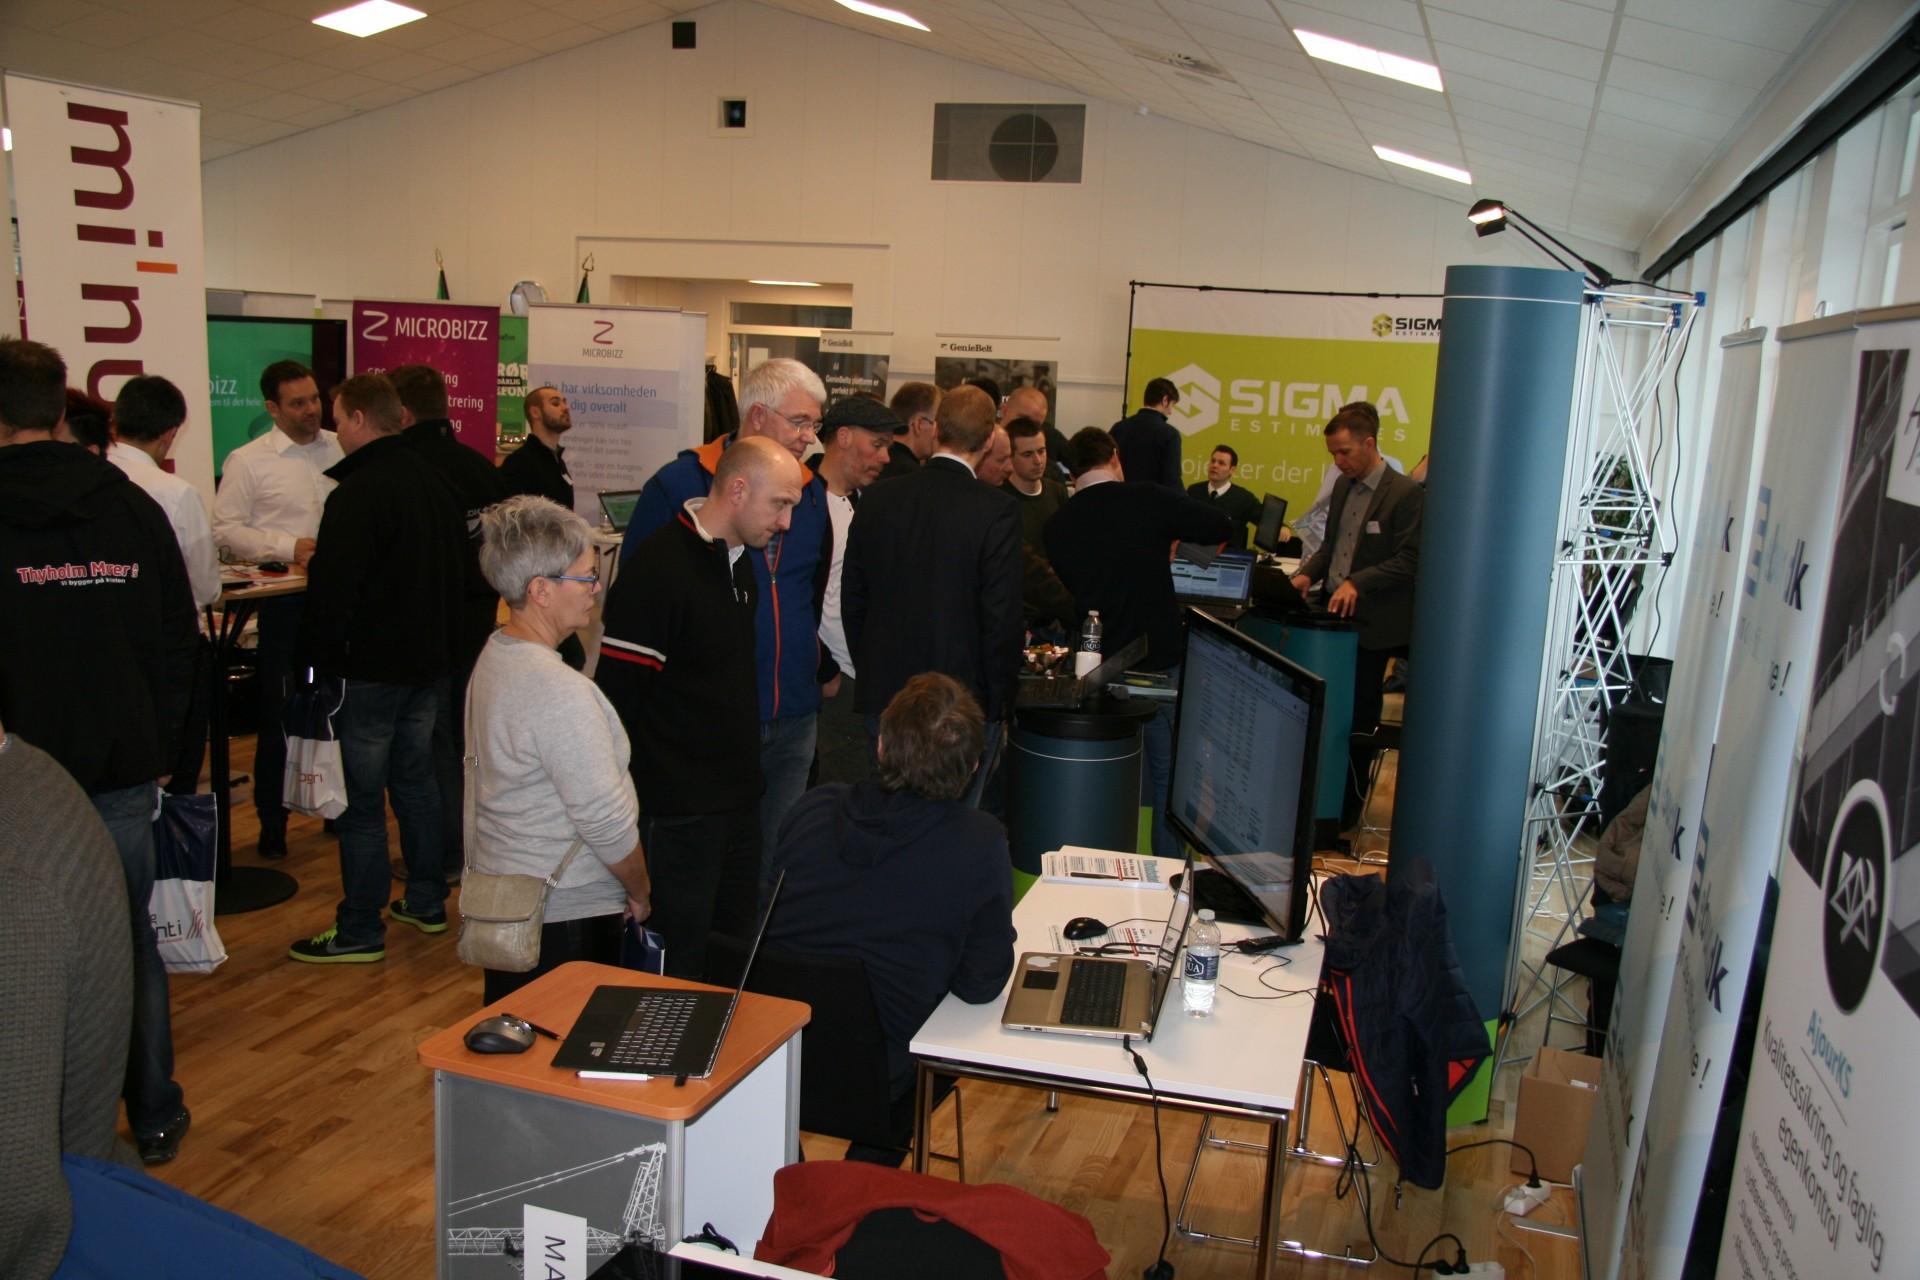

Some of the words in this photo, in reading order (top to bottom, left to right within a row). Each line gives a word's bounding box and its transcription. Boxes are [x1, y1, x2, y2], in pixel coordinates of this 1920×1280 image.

[395, 317, 489, 341] MICROBIZZ
[582, 349, 624, 359] MICROBIZZ
[950, 343, 992, 353] GenieBelt
[561, 382, 578, 394] har
[582, 383, 657, 399] virksomheden
[1229, 379, 1409, 424] SIGMA
[570, 400, 587, 414] dig
[590, 402, 627, 414] overalt
[1272, 460, 1312, 484] der
[17, 563, 87, 584] Thyholm
[1806, 1008, 1852, 1099] AjourKS
[1762, 1016, 1833, 1170] Kvalitetssikring
[1832, 1151, 1848, 1201] og
[1847, 1170, 1884, 1273] faglig
[1778, 1116, 1841, 1251] egenkontrol
